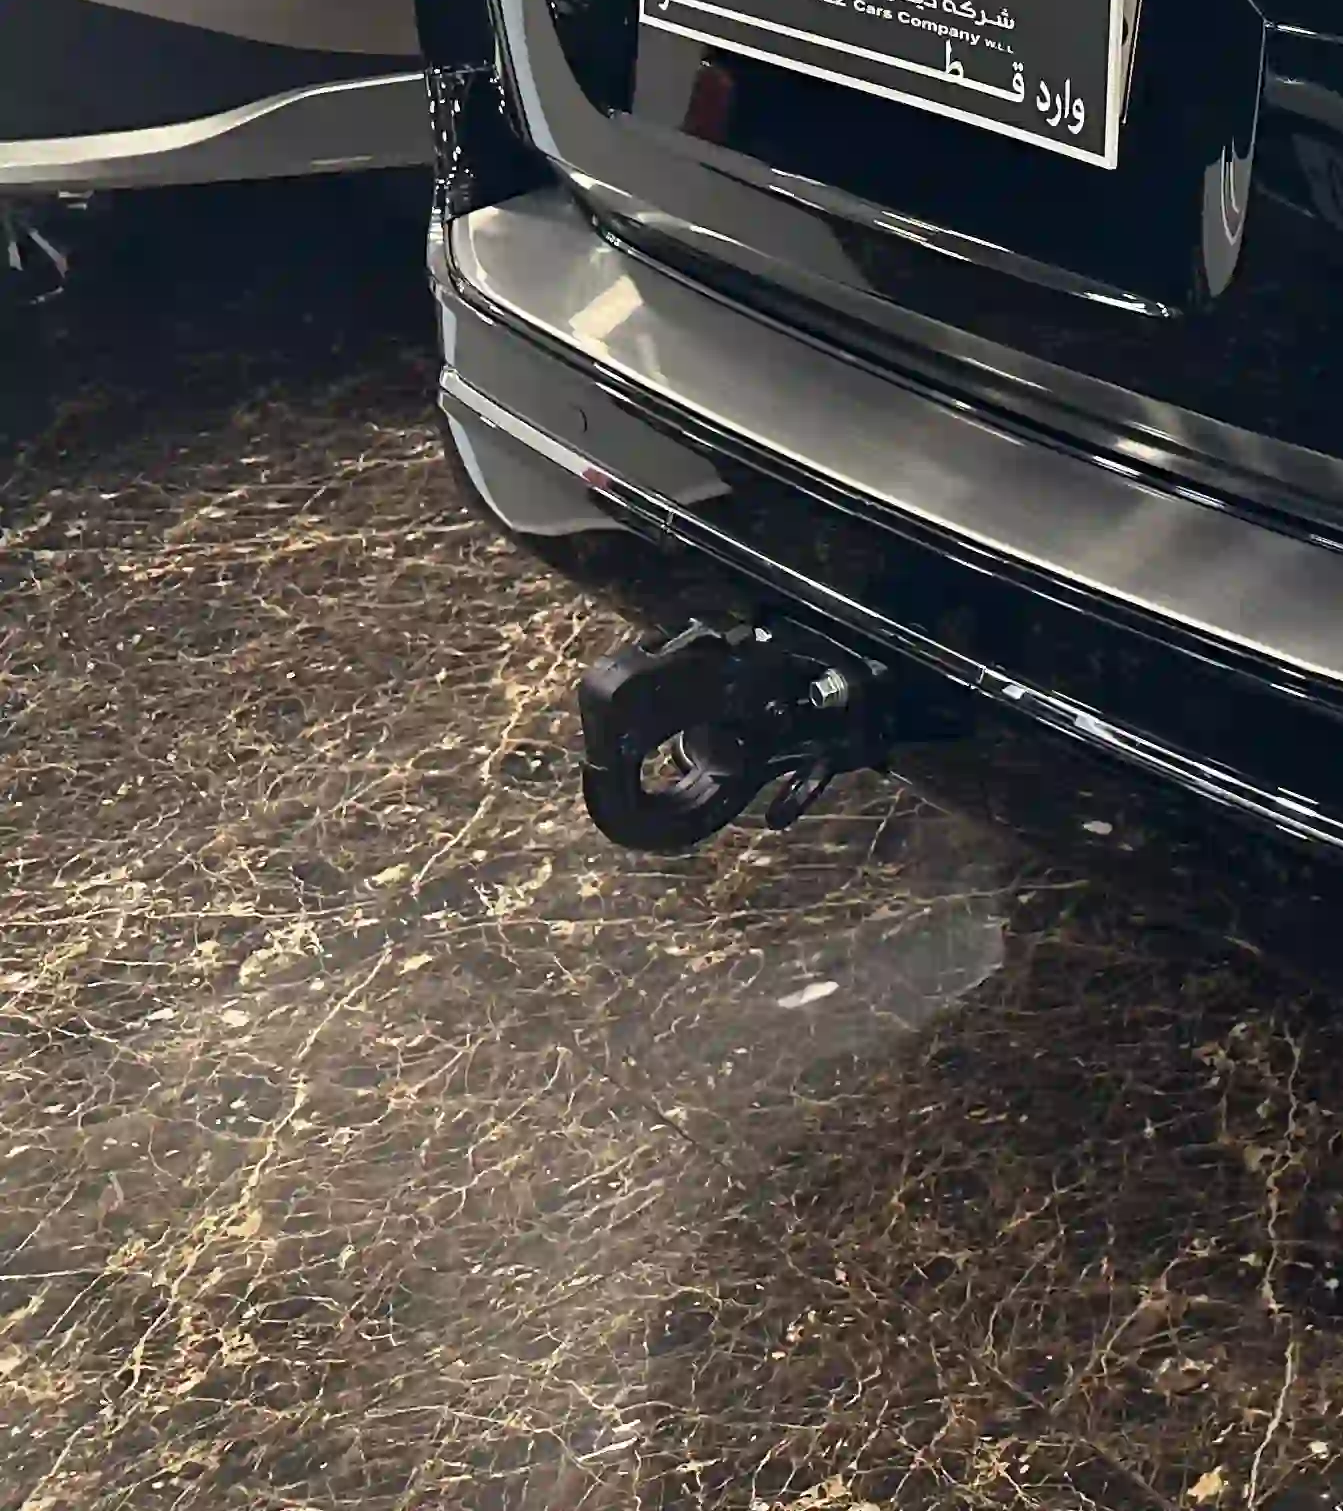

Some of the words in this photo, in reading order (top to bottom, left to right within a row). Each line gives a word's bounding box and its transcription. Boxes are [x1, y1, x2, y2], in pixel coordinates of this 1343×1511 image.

[853, 0, 893, 20] Cars
[897, 11, 981, 46] Company
[1036, 77, 1086, 135] وارد
